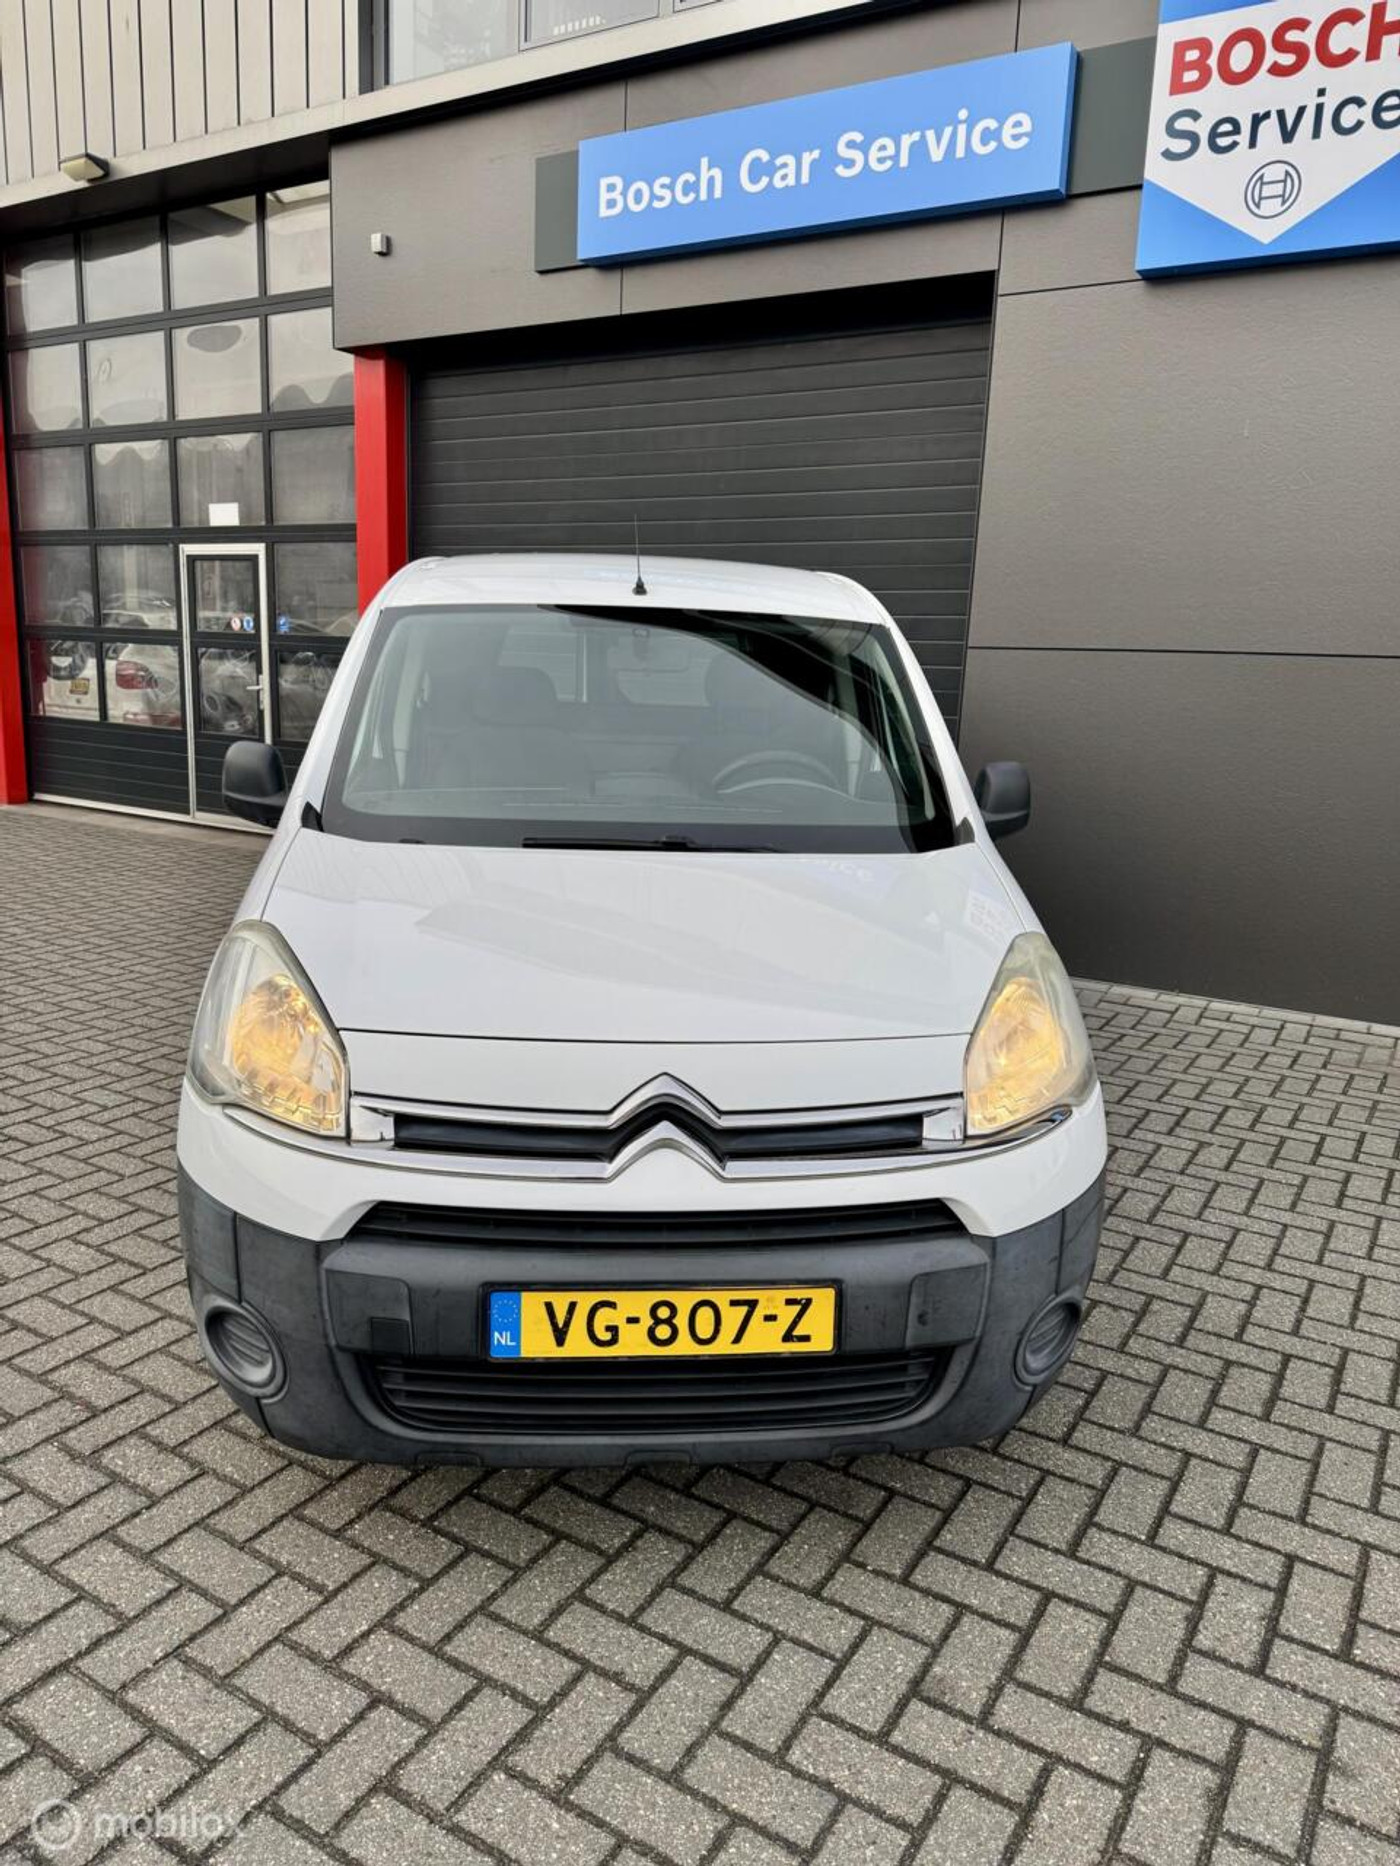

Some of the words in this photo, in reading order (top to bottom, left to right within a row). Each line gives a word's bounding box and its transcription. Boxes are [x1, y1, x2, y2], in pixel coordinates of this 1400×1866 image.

[1169, 0, 1400, 96] BOSCH
[1160, 87, 1400, 162] Service
[598, 156, 723, 219] Bosch
[739, 148, 820, 193] Car
[834, 107, 1033, 178] Service
[493, 1331, 517, 1346] NL
[544, 1297, 814, 1348] VG-807-Z
